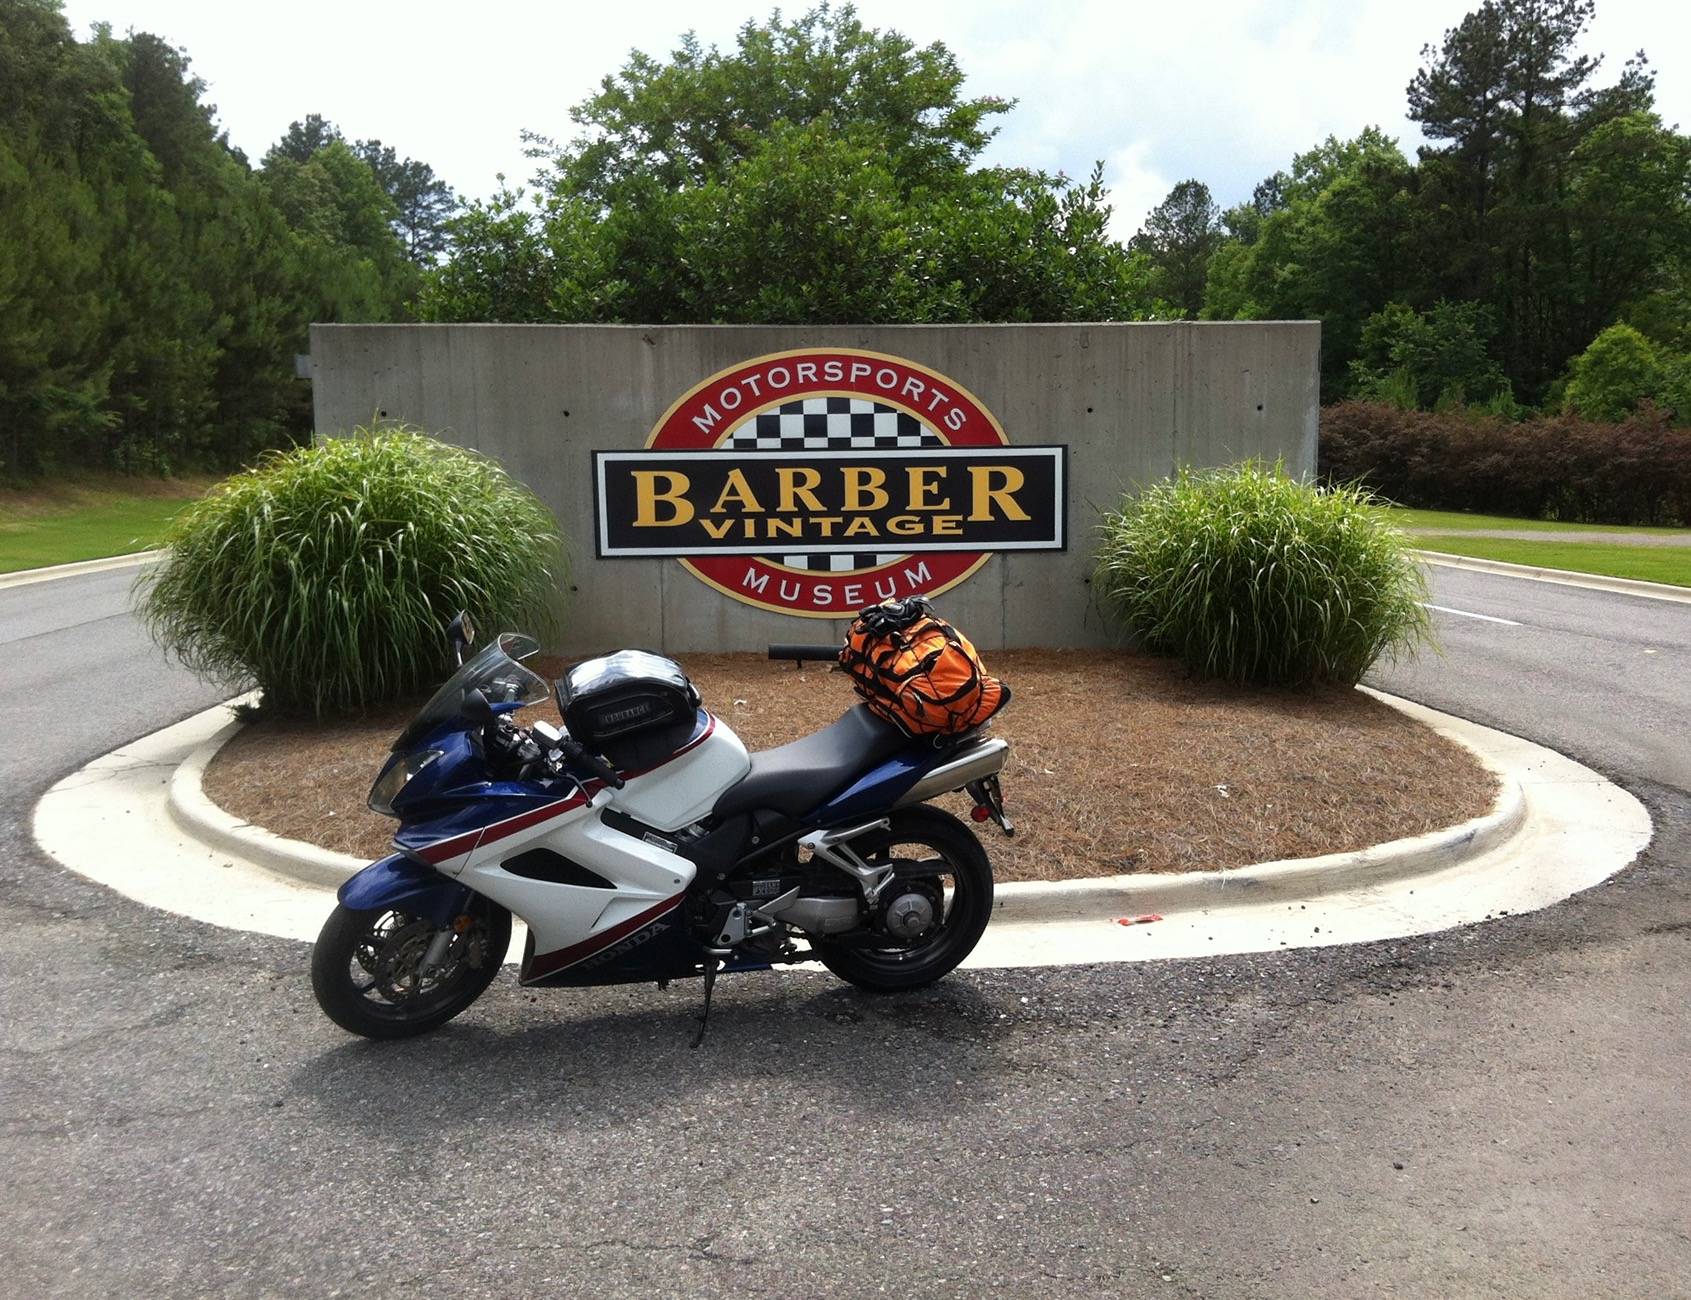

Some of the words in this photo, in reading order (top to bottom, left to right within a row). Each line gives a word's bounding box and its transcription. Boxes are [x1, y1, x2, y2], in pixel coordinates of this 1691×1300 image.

[691, 361, 967, 434] MOTORSPORTS
[630, 465, 1032, 527] BARBER
[698, 514, 963, 539] VINTAGE
[743, 561, 932, 605] MUSEUM
[582, 922, 672, 970] HONDA
